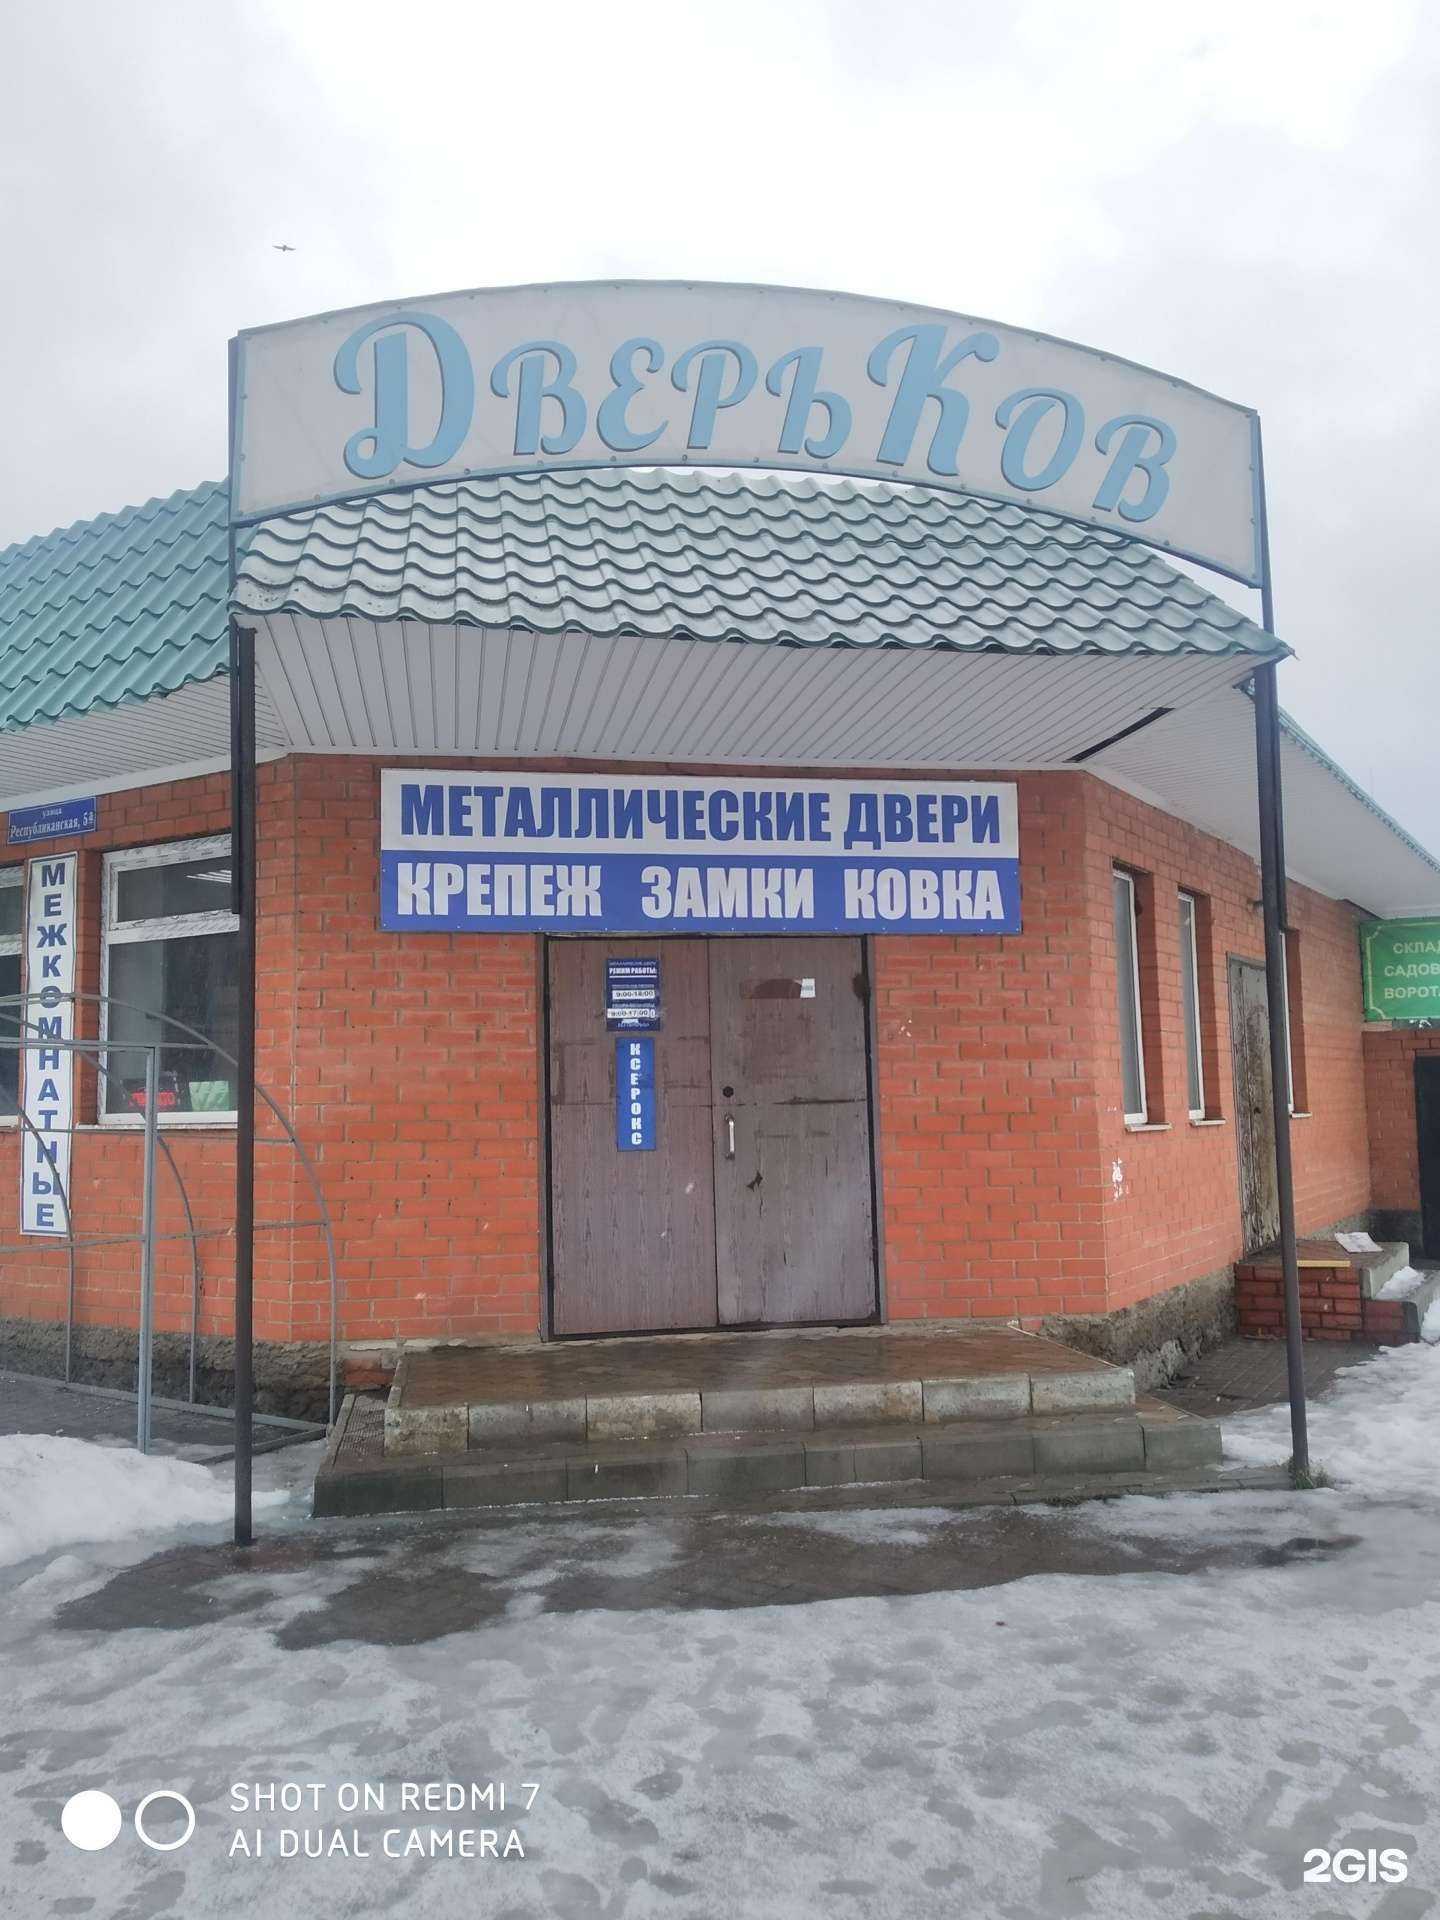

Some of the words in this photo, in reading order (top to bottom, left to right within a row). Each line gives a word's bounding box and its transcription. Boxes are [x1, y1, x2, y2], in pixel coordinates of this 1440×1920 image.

[401, 784, 832, 842] МЕТАЛЛИЧЕСКИЕ
[843, 793, 1001, 850] ДВЕРИ
[397, 862, 603, 917] КРЕПЕЖ
[641, 865, 815, 919] ЗАМКИ
[843, 867, 1005, 921] КОВКА
[1393, 941, 1440, 955] СКЛА
[1384, 986, 1440, 999] ВОРОТ
[32, 862, 68, 1227] МЕЖКОМНАТНЫЕ
[630, 1043, 642, 1145] КСЕРОКС
